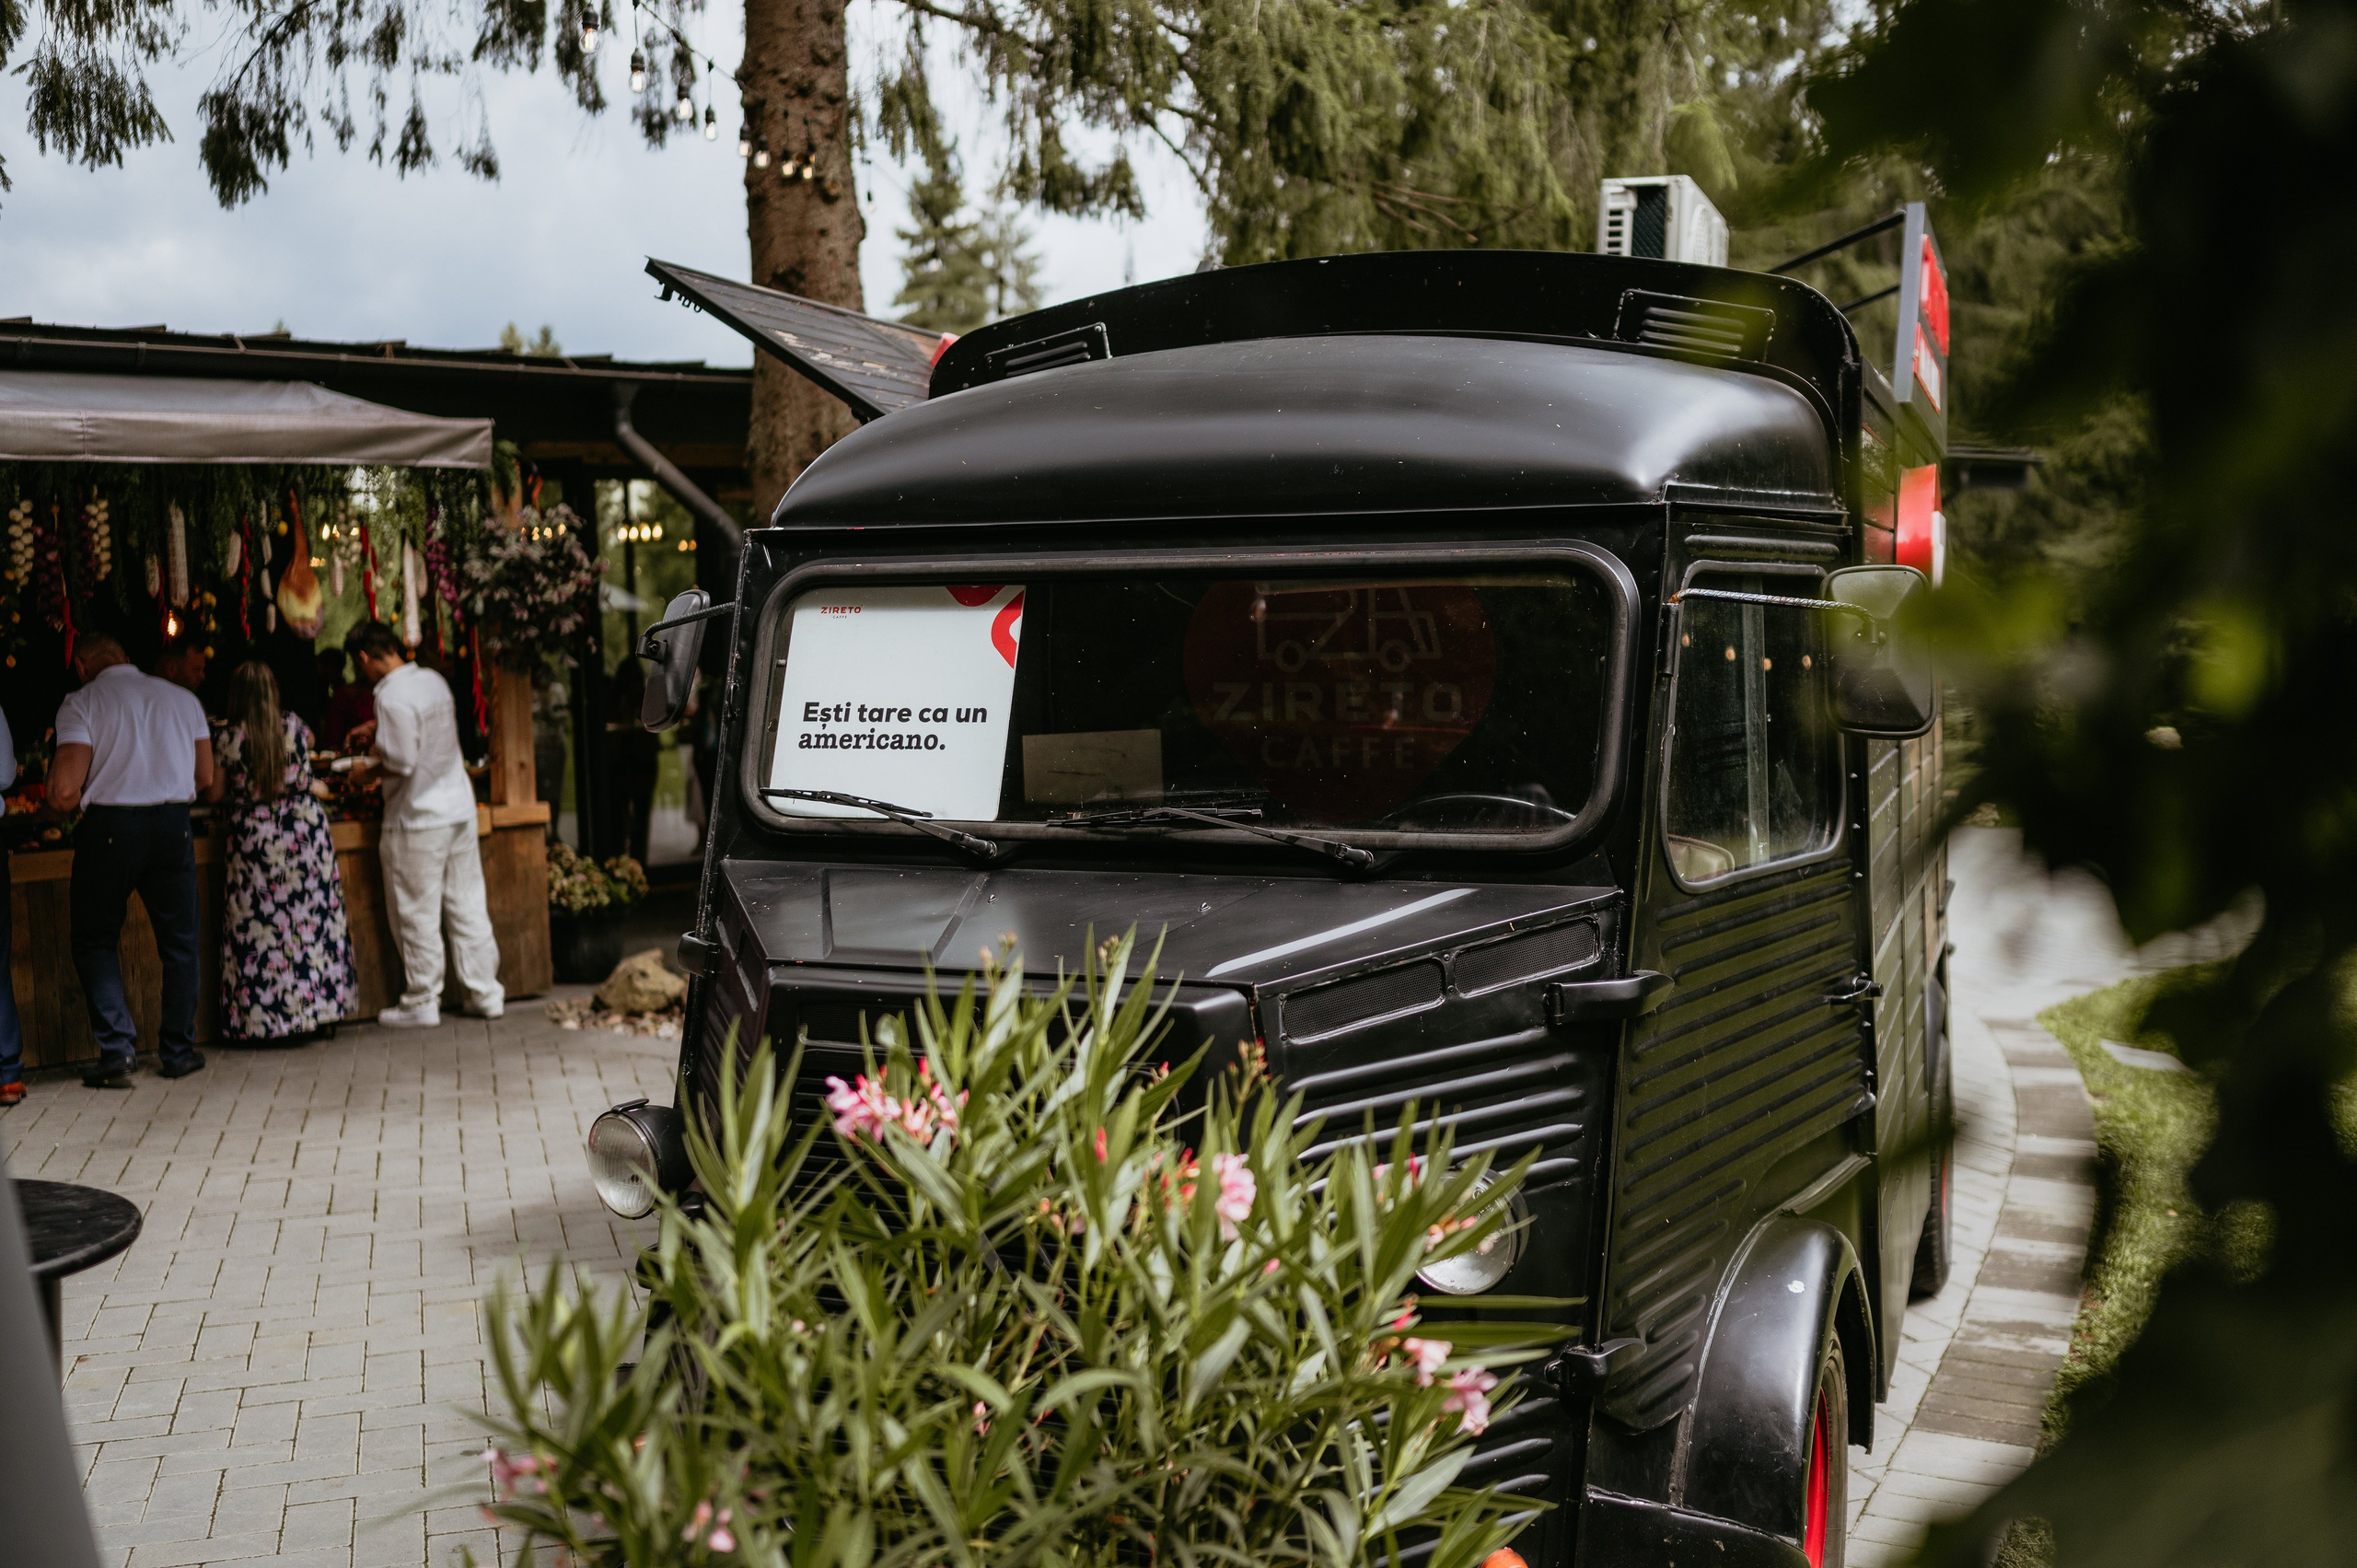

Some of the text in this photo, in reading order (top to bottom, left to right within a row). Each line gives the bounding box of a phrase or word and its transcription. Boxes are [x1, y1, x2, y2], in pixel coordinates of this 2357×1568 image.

[820, 606, 862, 614] ZIRETO
[1213, 681, 1463, 722] ZIRETO
[803, 702, 988, 730] Ești tare ca un
[798, 727, 946, 750] americano.
[1260, 736, 1415, 770] CAFFE
